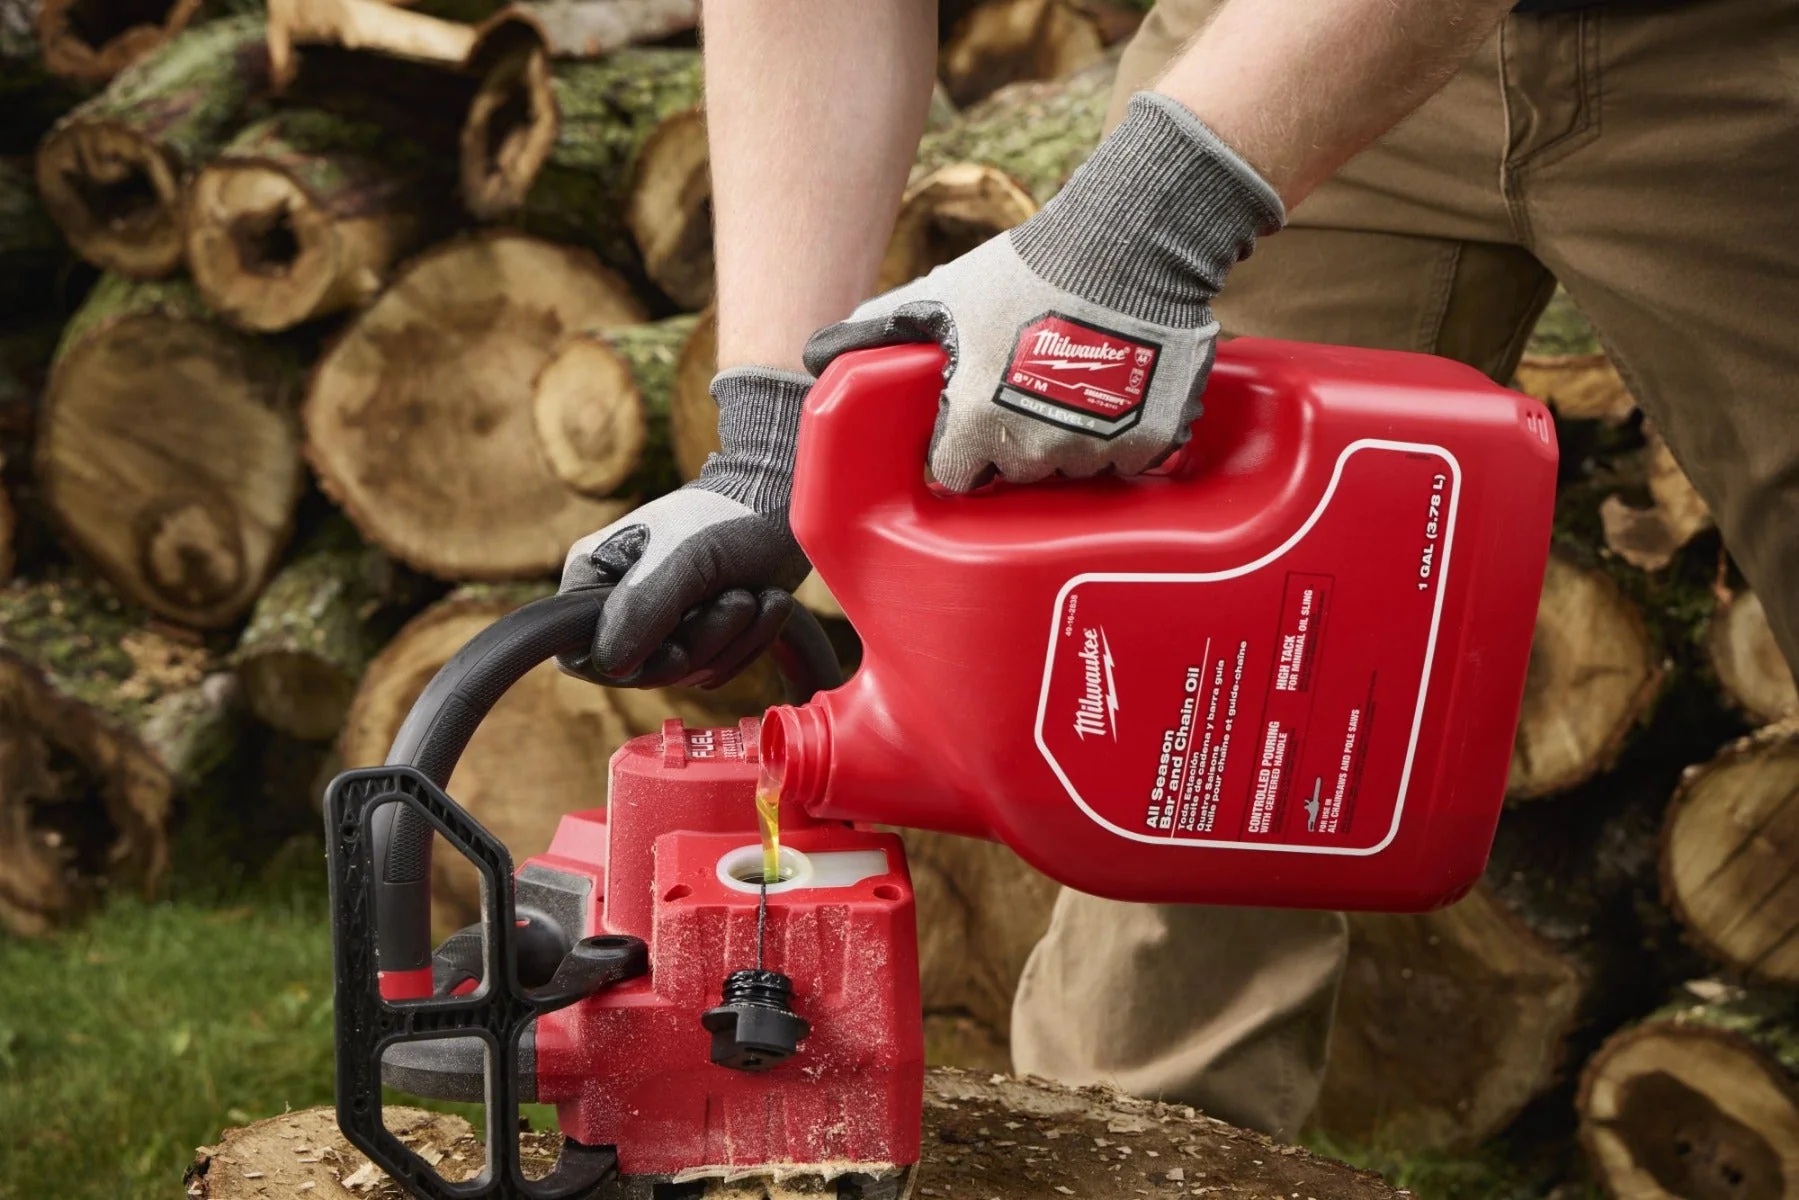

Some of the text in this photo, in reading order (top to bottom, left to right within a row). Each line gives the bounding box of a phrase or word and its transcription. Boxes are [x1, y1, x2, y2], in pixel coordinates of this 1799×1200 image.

[1032, 329, 1127, 361] Milwaukee
[1034, 380, 1048, 392] M
[1020, 399, 1096, 428] CUT LEVEL 4
[1418, 474, 1446, 591] 1 GAL (3.78 L)
[1301, 589, 1313, 616] SLING
[1298, 617, 1309, 632] OIL
[1275, 634, 1295, 690] HIGH TACK
[1291, 633, 1306, 672] MINIMAL
[1073, 628, 1106, 741] Milwaukee
[1287, 673, 1299, 691] FOR
[1206, 687, 1220, 721] barra
[691, 730, 714, 758] FUEL
[1160, 667, 1200, 829] Bar and Chain Oil
[1197, 732, 1212, 776] cadena
[1273, 732, 1287, 767] HANDLE
[1146, 729, 1175, 828] All Season
[1194, 778, 1203, 793] de
[1196, 745, 1220, 831] Quatre Saisons
[1204, 804, 1217, 832] Huile
[1211, 774, 1222, 802] pour
[1224, 718, 1233, 732] et
[1248, 720, 1280, 833] CONTROLLED POURING
[1264, 768, 1281, 811] CENTERED
[1327, 709, 1360, 834] ALL CHAINSAWS AND POLE SAWS
[1178, 751, 1200, 830] Toda Estación
[1186, 795, 1200, 831] Aceite
[1259, 812, 1272, 833] WITH
[1322, 806, 1331, 819] USE
